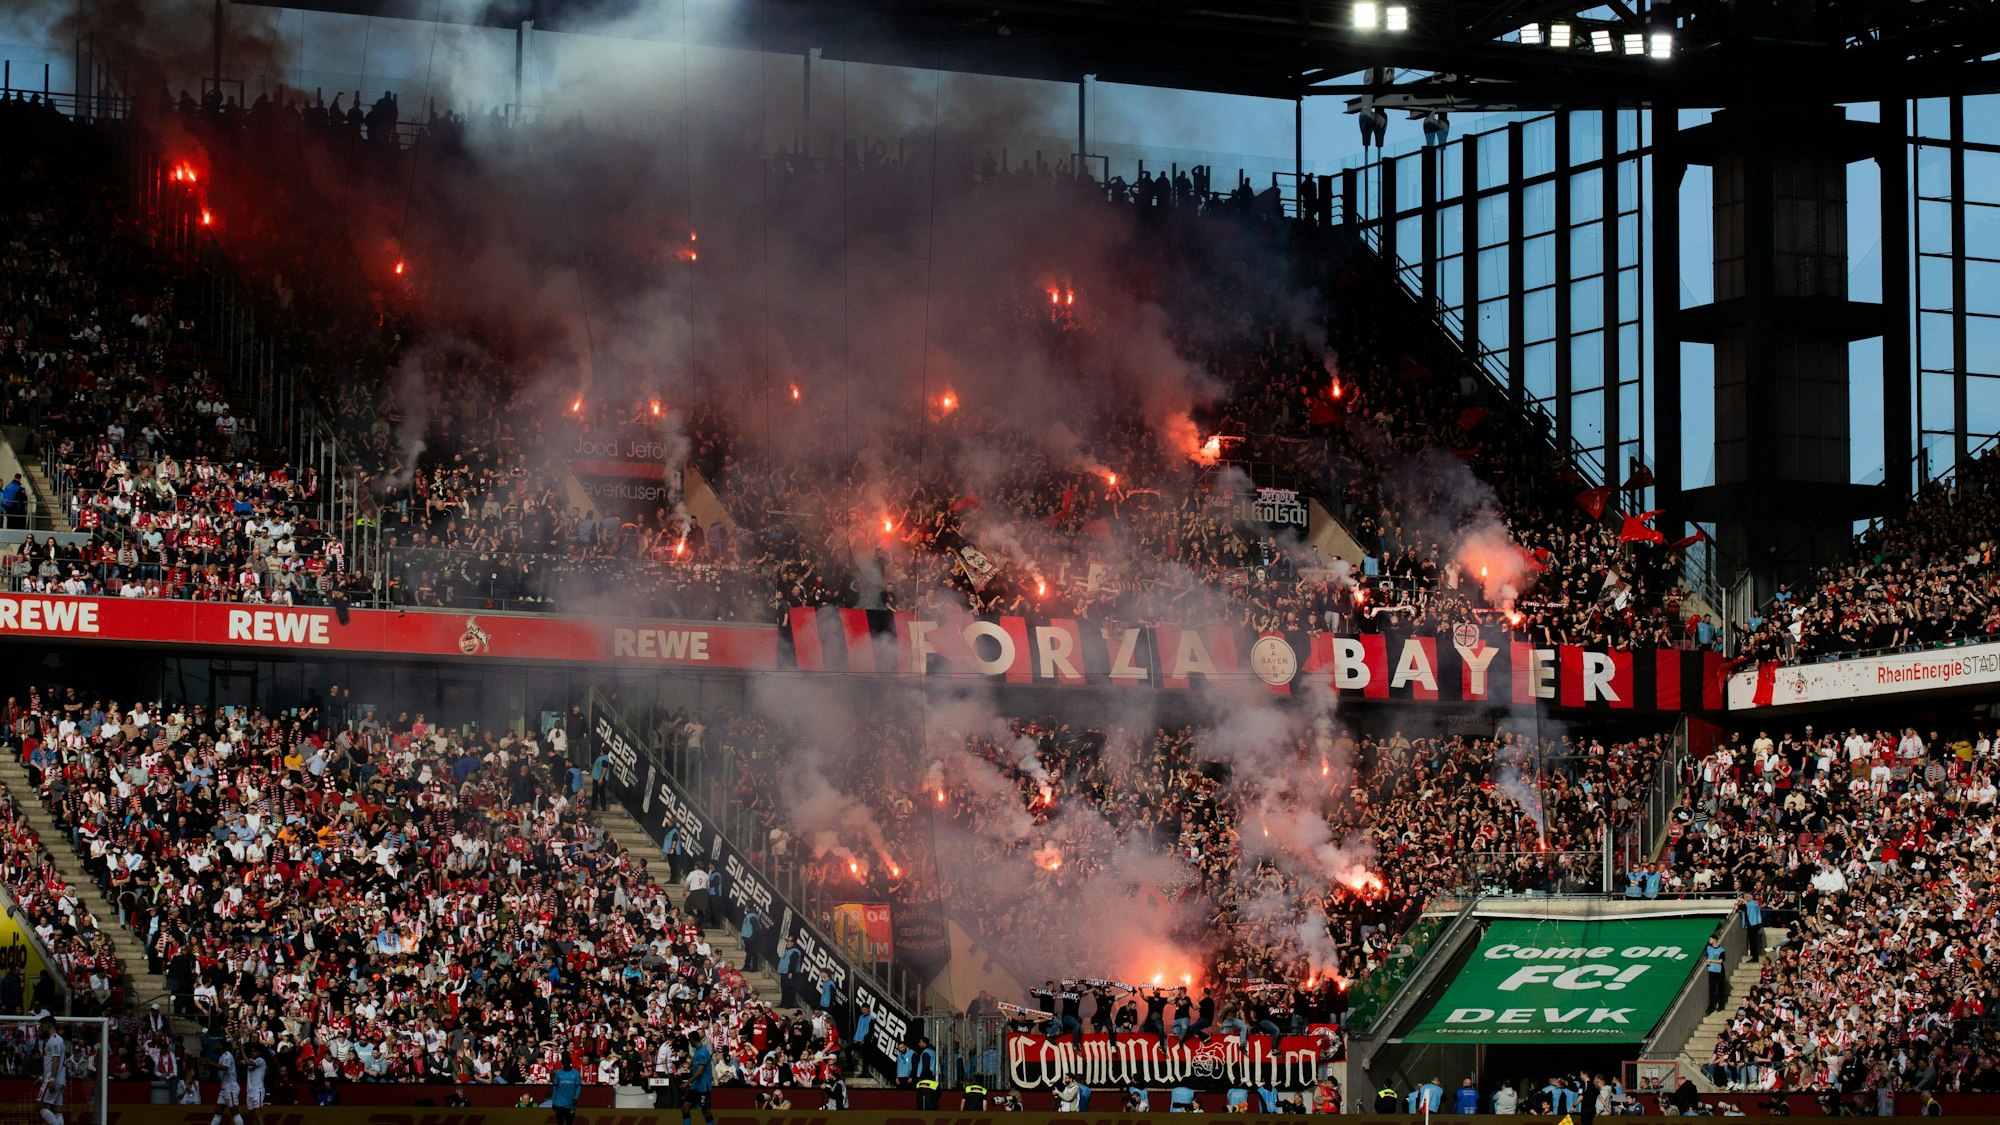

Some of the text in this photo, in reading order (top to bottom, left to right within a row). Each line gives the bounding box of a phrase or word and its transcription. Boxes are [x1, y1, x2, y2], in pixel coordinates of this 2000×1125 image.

[575, 438, 618, 457] Jood
[0, 599, 100, 633] REWE
[228, 609, 330, 645] REWE
[614, 628, 709, 661] REWE
[908, 620, 1621, 702] FORZA BAYER
[1261, 657, 1288, 665] BAYER
[595, 716, 637, 772] SILBER
[658, 783, 703, 841] SILBER
[725, 854, 772, 914] SILBER
[796, 927, 846, 990] SILBER
[1484, 944, 1689, 961] Come on,
[1496, 964, 1652, 992] FC!
[855, 985, 907, 1042] SILBER
[1444, 1008, 1638, 1024] DEVK
[1551, 1028, 1623, 1036] Geholfen.
[1009, 1035, 1190, 1088] Commando
